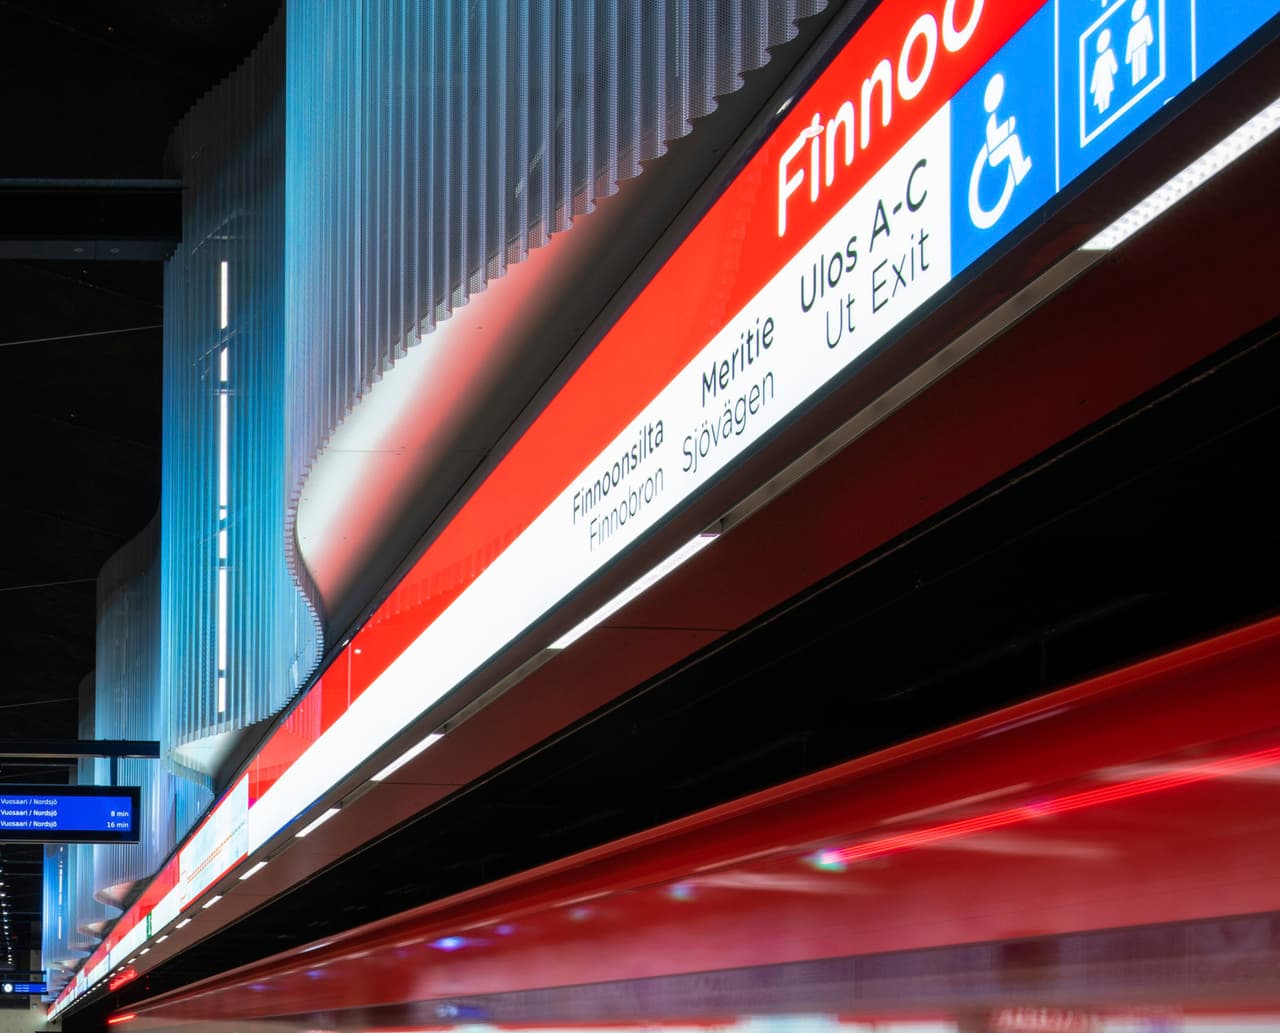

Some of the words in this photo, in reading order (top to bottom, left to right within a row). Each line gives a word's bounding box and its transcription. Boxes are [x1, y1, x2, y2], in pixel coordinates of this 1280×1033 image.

[801, 236, 858, 313] Ulos
[869, 158, 928, 253] A-C
[826, 293, 856, 349] Ut
[872, 228, 930, 314] Exit
[702, 316, 775, 408] Meritie
[682, 371, 775, 473] Sjövägen
[573, 419, 665, 525] Finnoonsilta
[589, 467, 665, 552] Finnobron
[33, 797, 58, 807] Nordsjö
[33, 808, 58, 818] Nordsjö
[33, 819, 58, 829] Nordsjö
